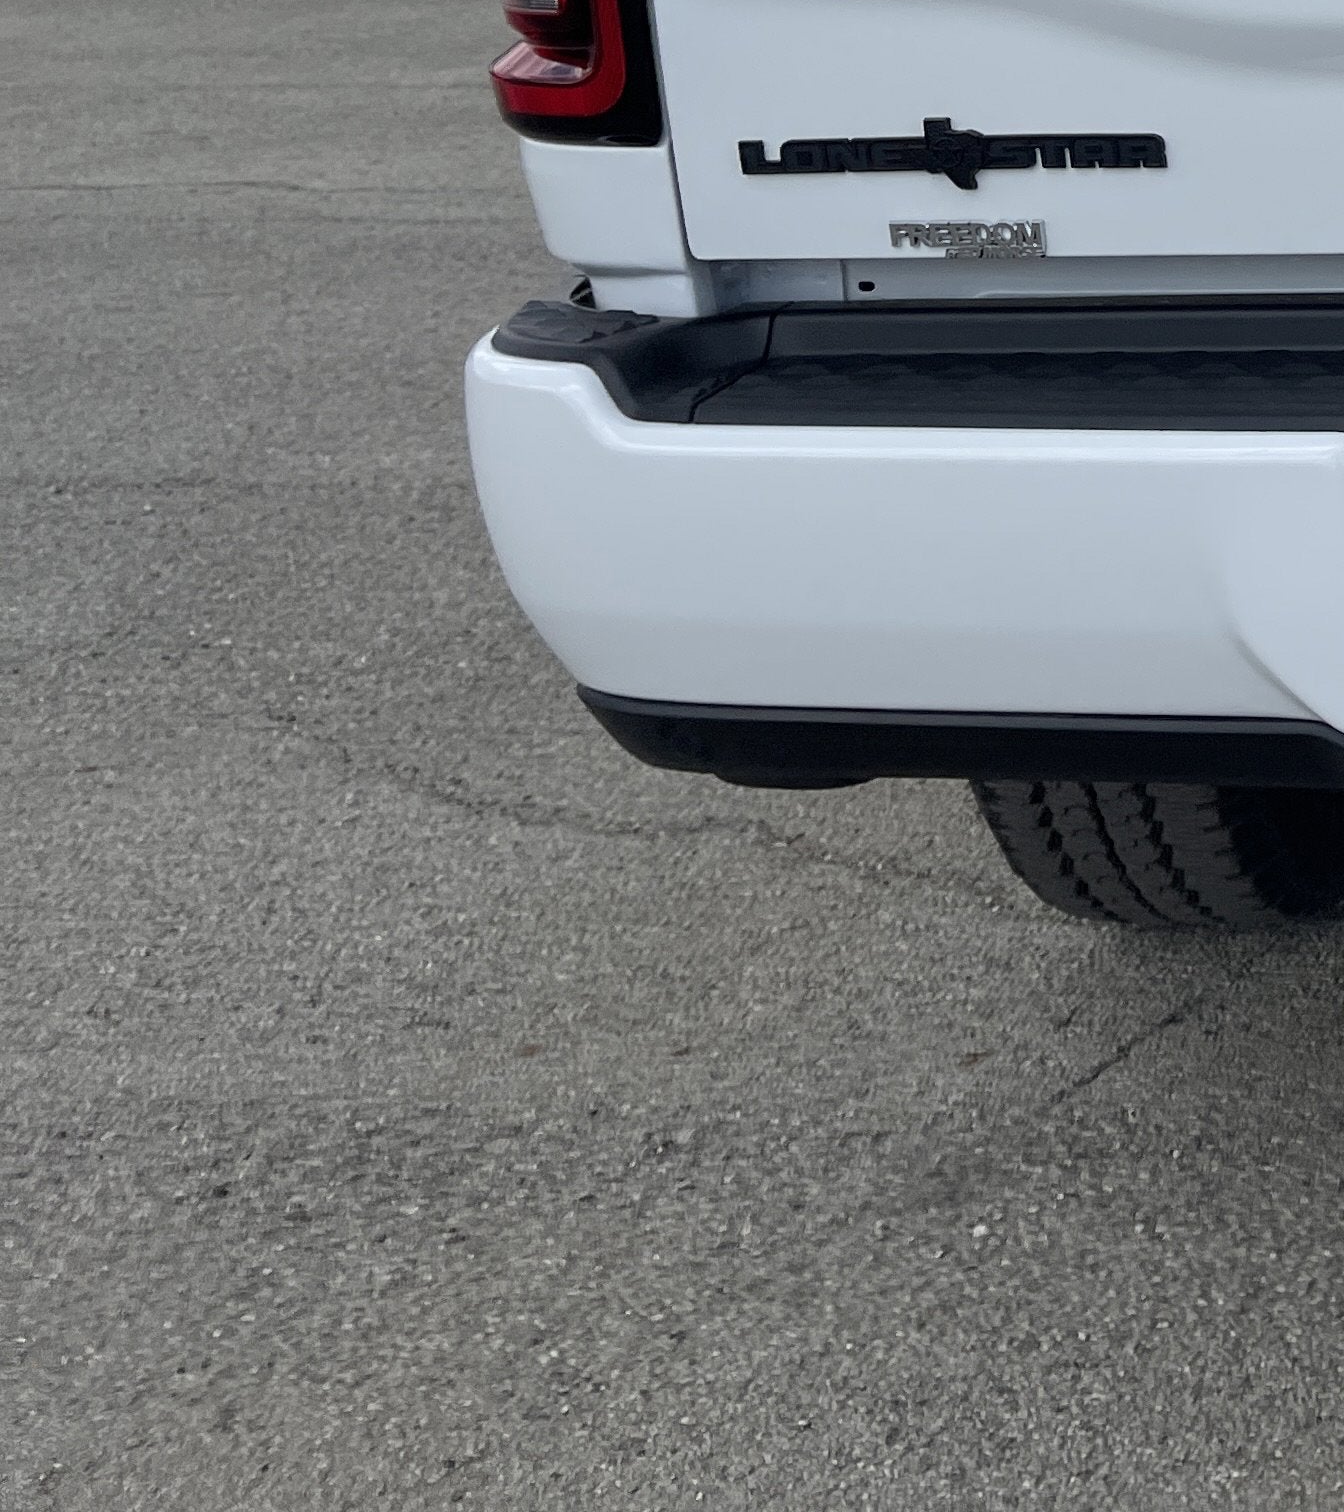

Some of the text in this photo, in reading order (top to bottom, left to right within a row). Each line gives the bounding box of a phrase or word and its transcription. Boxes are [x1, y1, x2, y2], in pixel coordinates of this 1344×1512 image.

[738, 133, 1168, 174] LONE STAR
[889, 221, 1045, 248] FREEDOM
